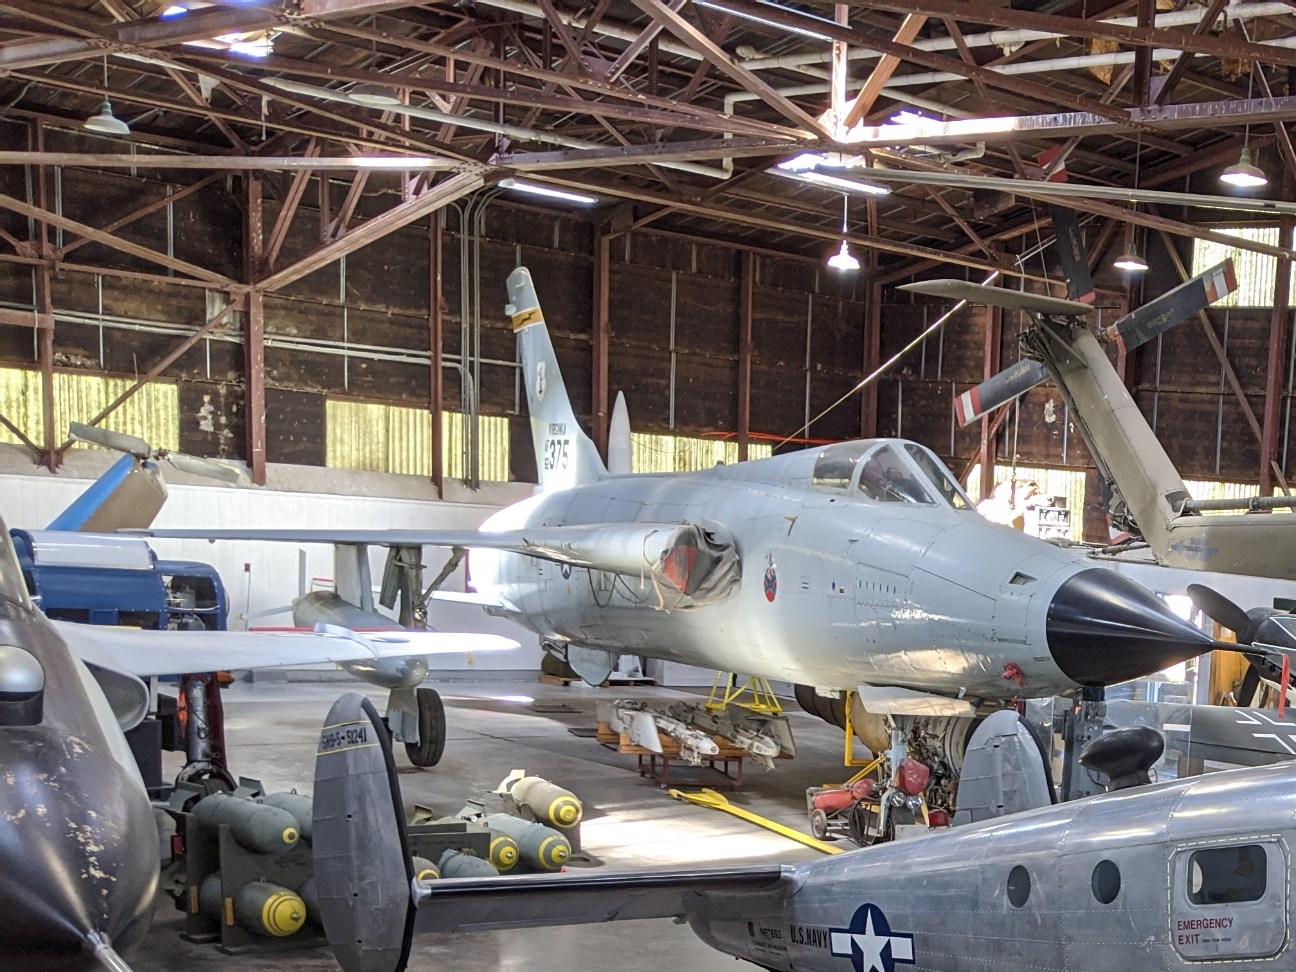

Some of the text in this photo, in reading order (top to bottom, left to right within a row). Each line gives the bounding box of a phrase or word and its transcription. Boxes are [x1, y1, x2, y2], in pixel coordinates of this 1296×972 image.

[549, 423, 567, 436] VIRGINIA
[550, 439, 570, 470] 375
[1177, 917, 1234, 931] EMERGENCY
[1178, 934, 1200, 945] EXIT
